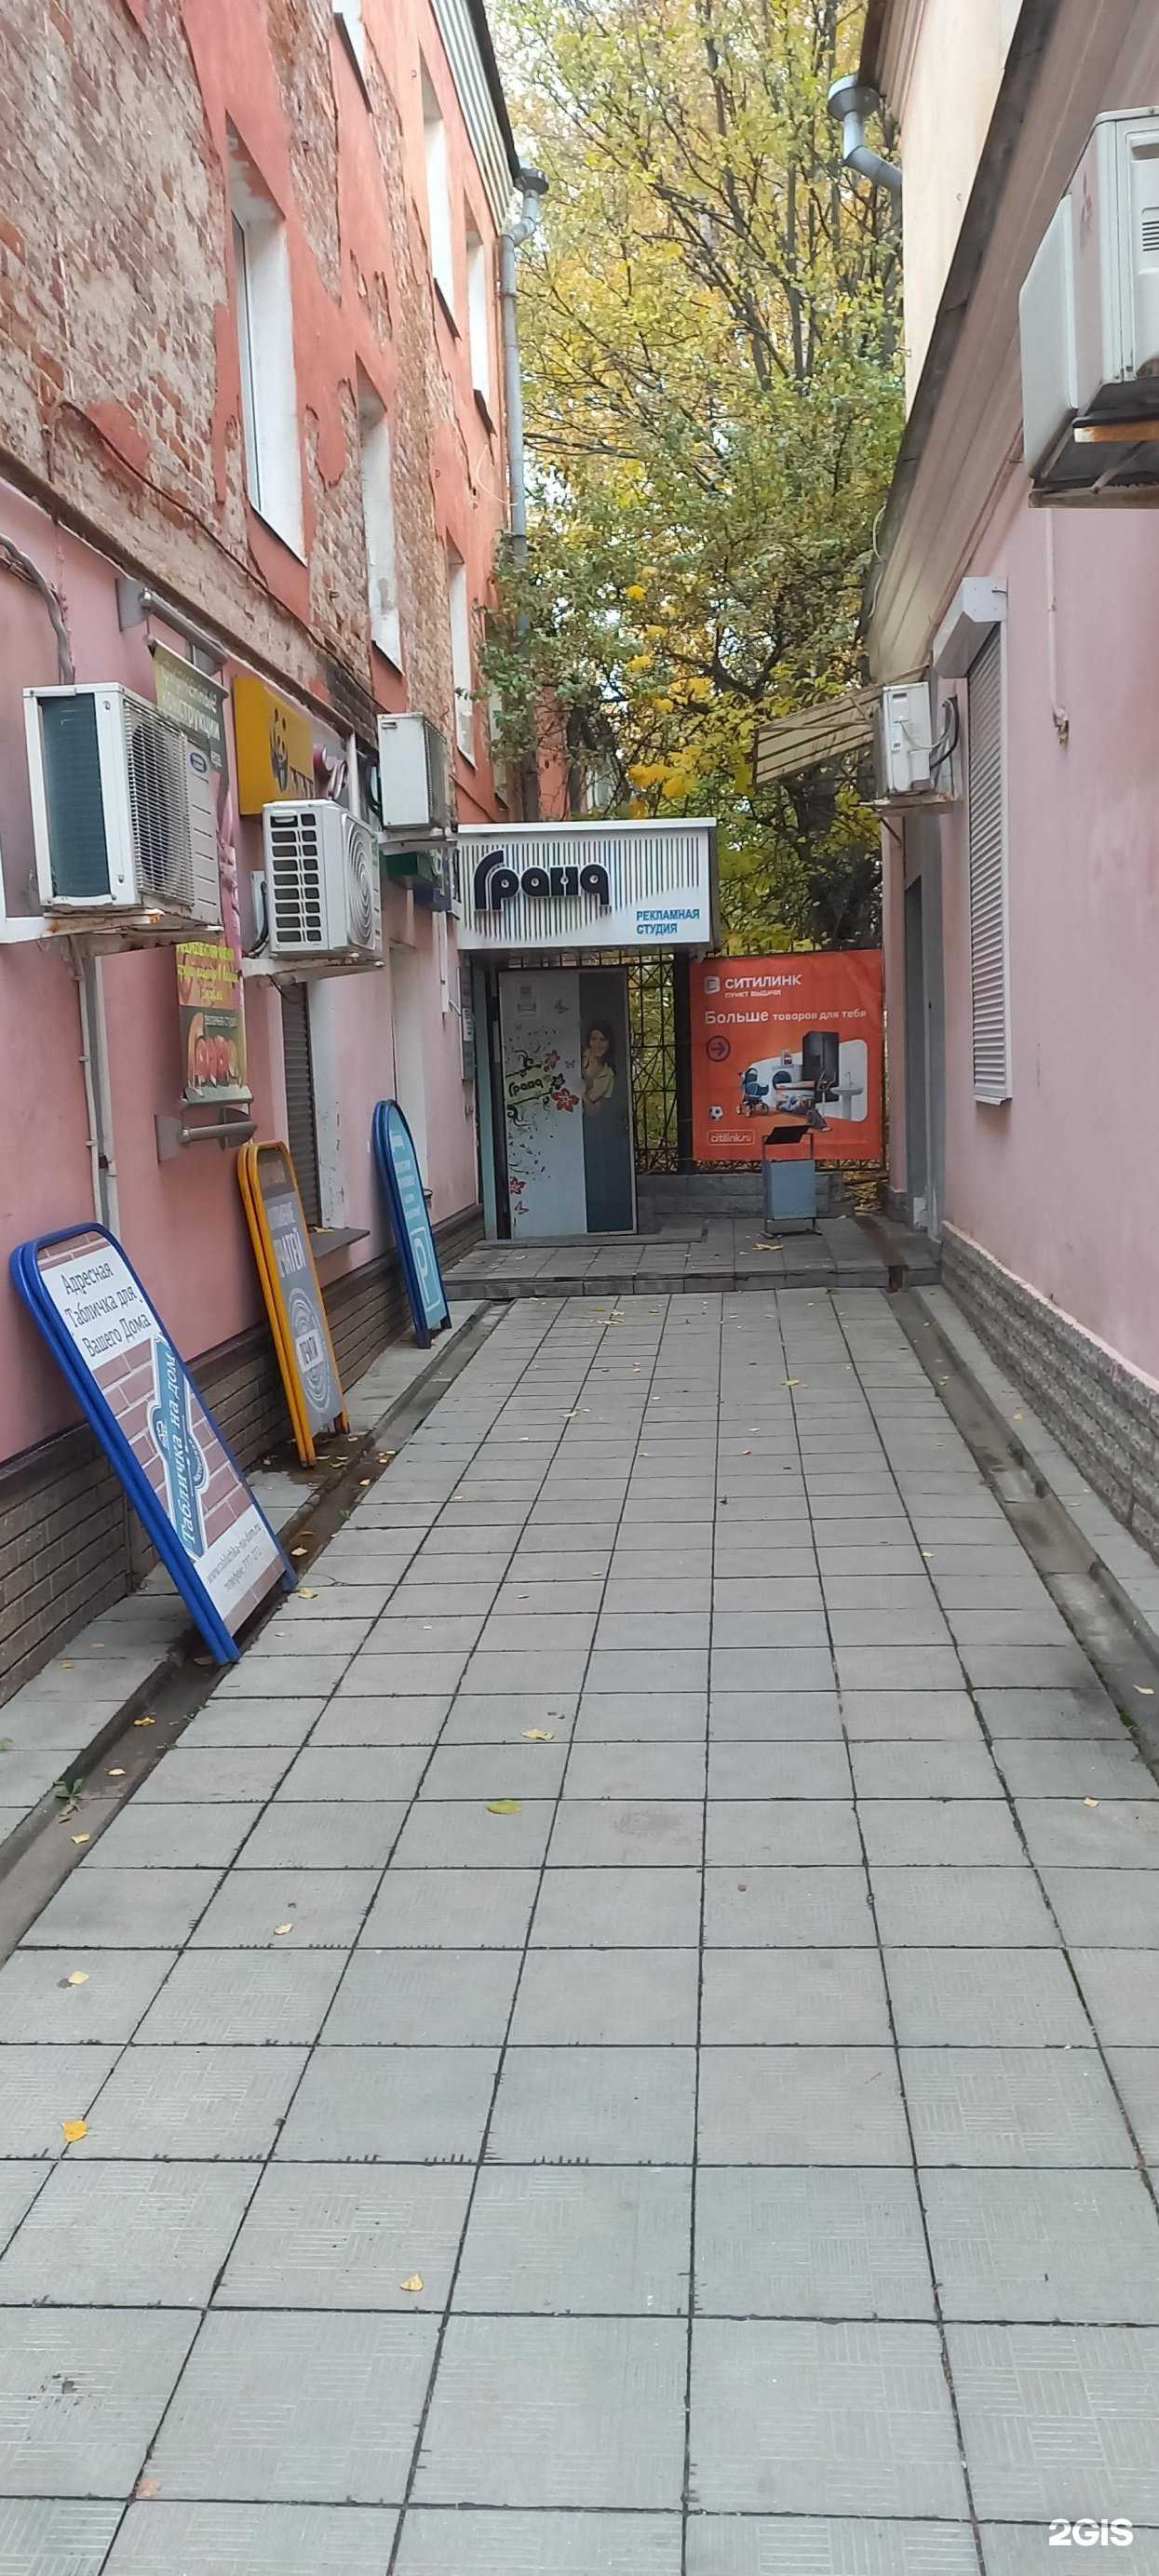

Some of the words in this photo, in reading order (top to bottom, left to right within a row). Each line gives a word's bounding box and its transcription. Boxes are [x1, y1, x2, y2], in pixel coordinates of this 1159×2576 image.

[636, 908, 700, 921] РЕКЛАМНАЯ
[636, 923, 678, 935] СТУДИЯ
[724, 974, 802, 989] СИТИЛИНК
[705, 1011, 769, 1025] Больше
[773, 1013, 817, 1023] товаров
[818, 1012, 839, 1022] для
[841, 1008, 867, 1019] тебя
[61, 1263, 114, 1295] Адресная
[64, 1295, 118, 1328] Табличка
[116, 1286, 138, 1309] для
[82, 1328, 122, 1357] Вашего
[119, 1313, 151, 1343] Дома
[164, 1350, 181, 1400] дом
[168, 1402, 181, 1429] на
[172, 1437, 195, 1546] Табличка
